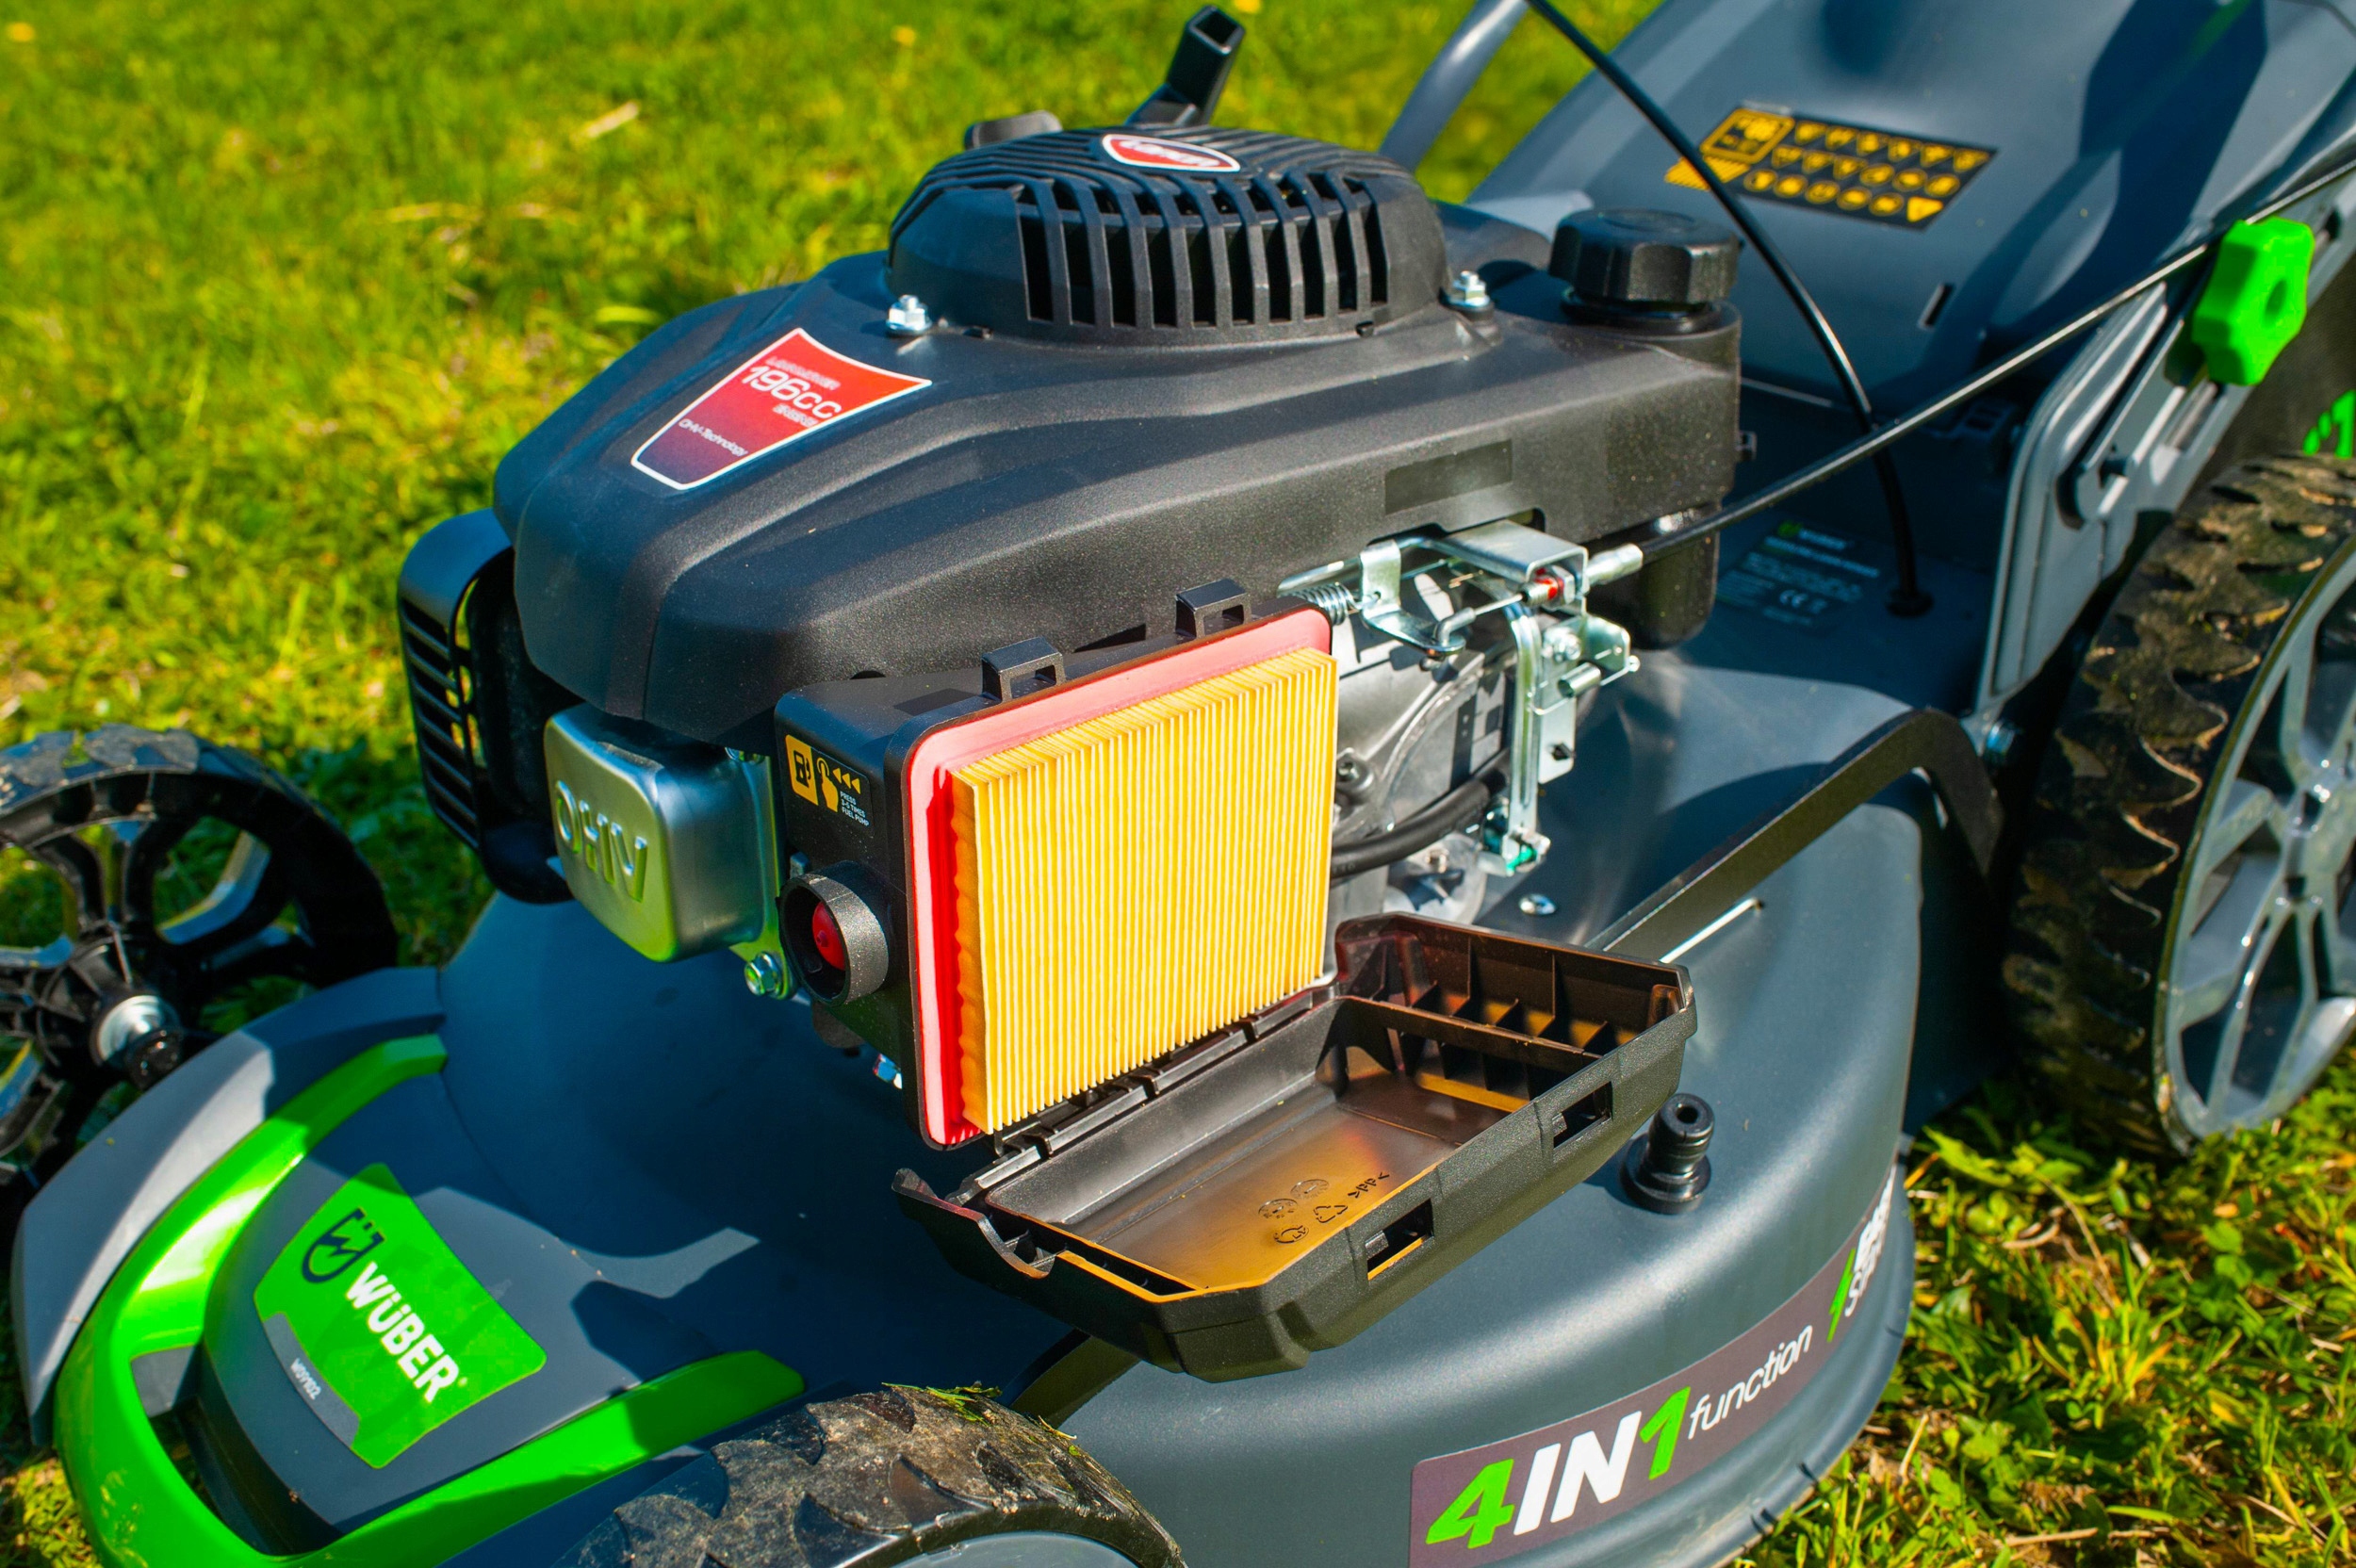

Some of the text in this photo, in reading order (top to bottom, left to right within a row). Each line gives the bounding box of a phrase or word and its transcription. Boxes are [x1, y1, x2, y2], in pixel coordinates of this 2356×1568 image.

[743, 365, 842, 419] 196cc
[556, 779, 648, 904] OHV
[842, 806, 870, 827] FUEL PUMP
[850, 804, 866, 819] TIMES
[345, 1261, 460, 1403] WÜBER
[1688, 1324, 1814, 1441] function
